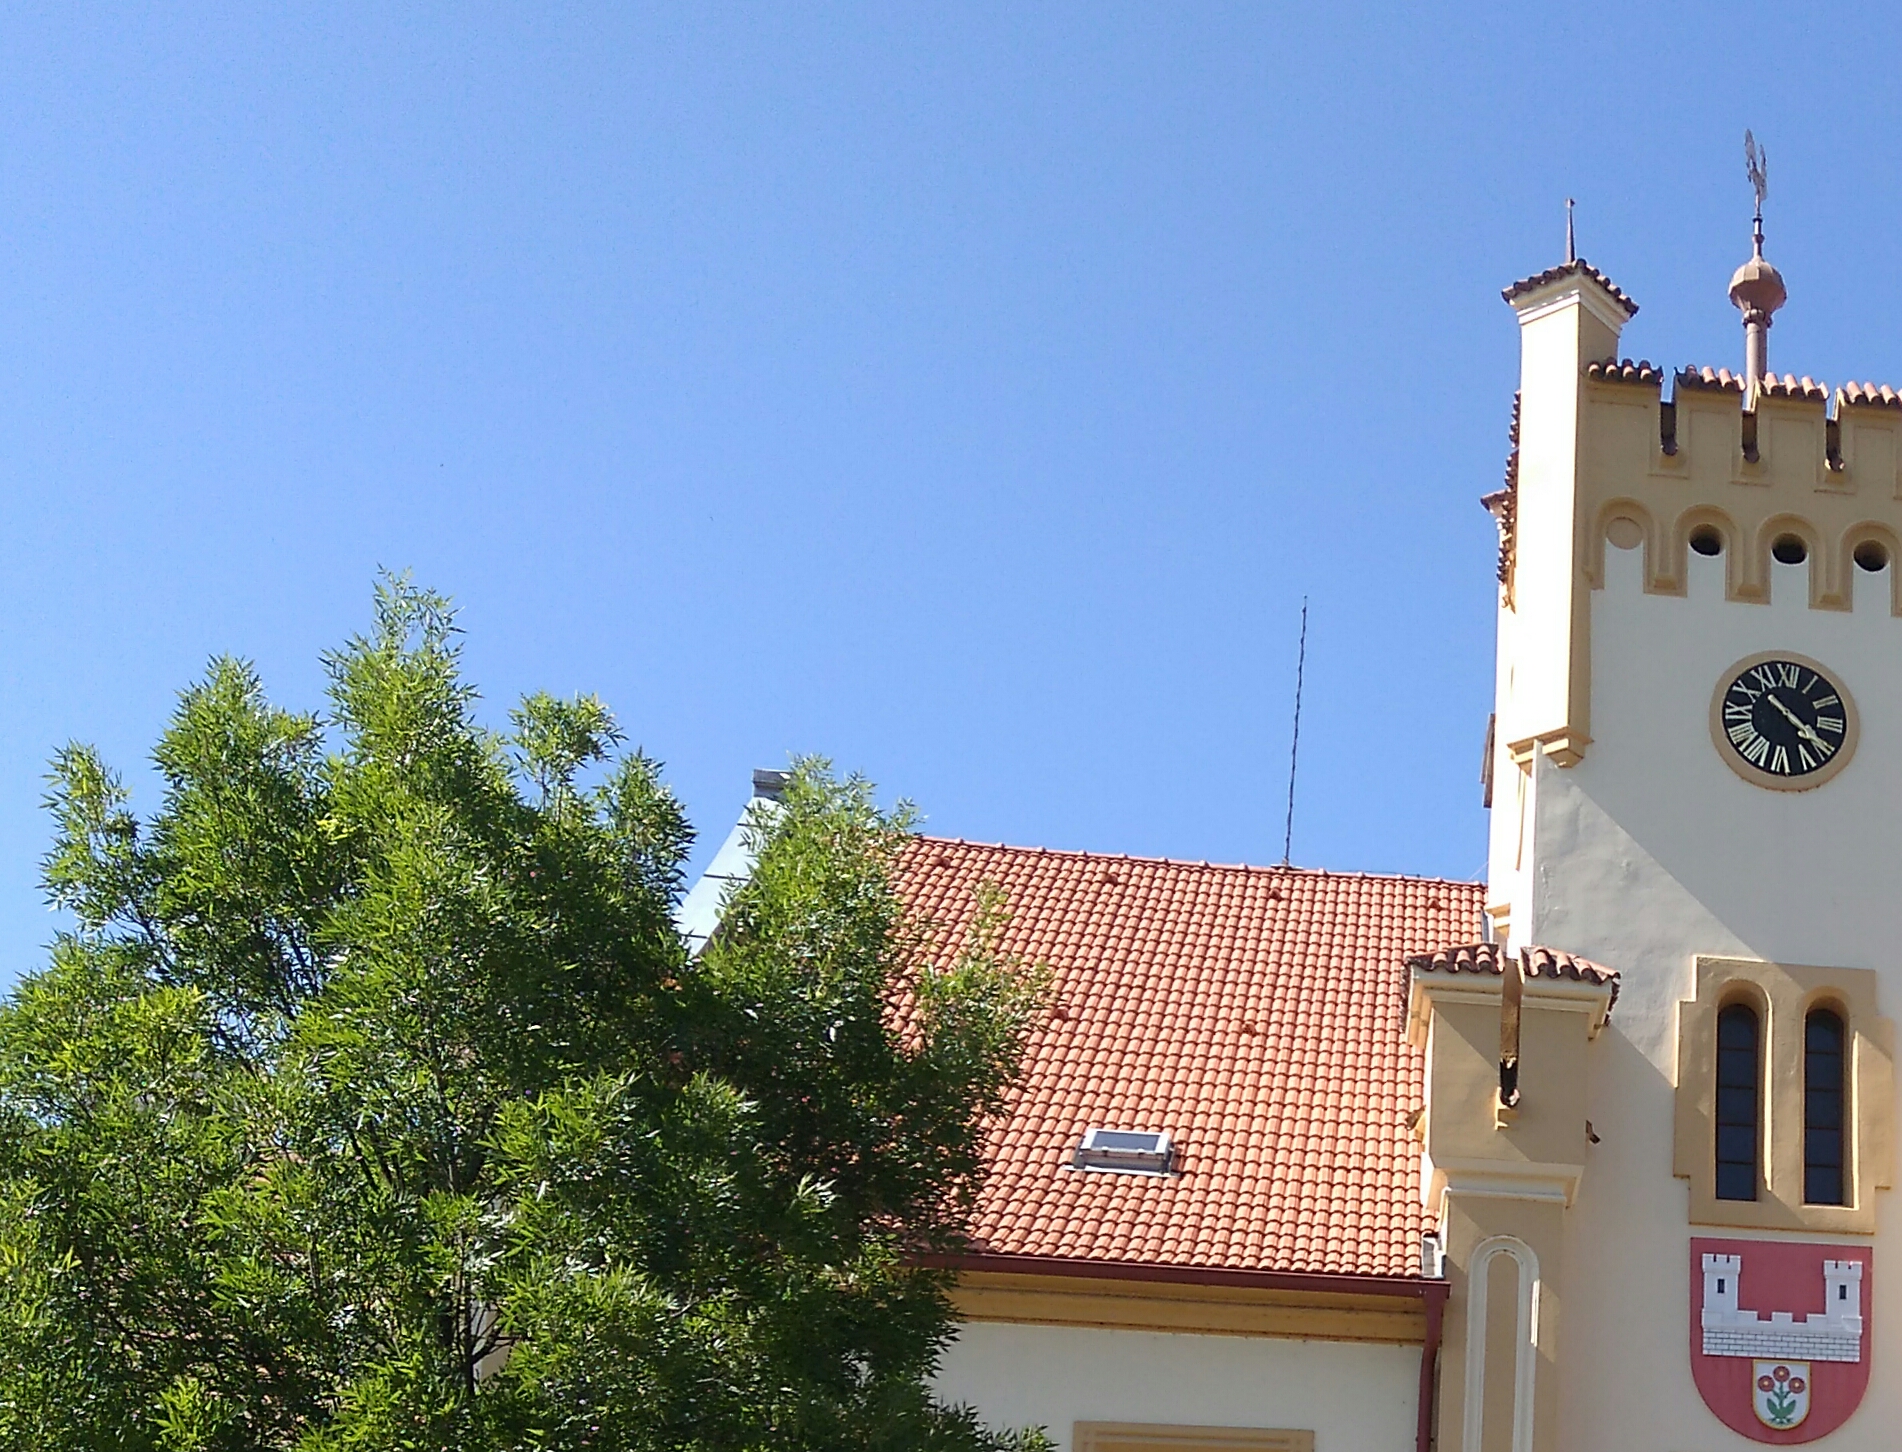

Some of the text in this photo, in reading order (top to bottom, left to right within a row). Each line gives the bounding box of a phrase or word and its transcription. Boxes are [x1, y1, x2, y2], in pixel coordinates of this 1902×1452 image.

[1749, 664, 1777, 692] XI
[1776, 663, 1800, 689] XII
[1802, 674, 1818, 694] I
[1732, 679, 1762, 703] X
[1812, 694, 1839, 710] II
[1725, 700, 1753, 720] IX
[1816, 715, 1843, 734] III
[1742, 735, 1771, 768] VII
[1770, 744, 1791, 773] VI
[1798, 743, 1818, 771] V
